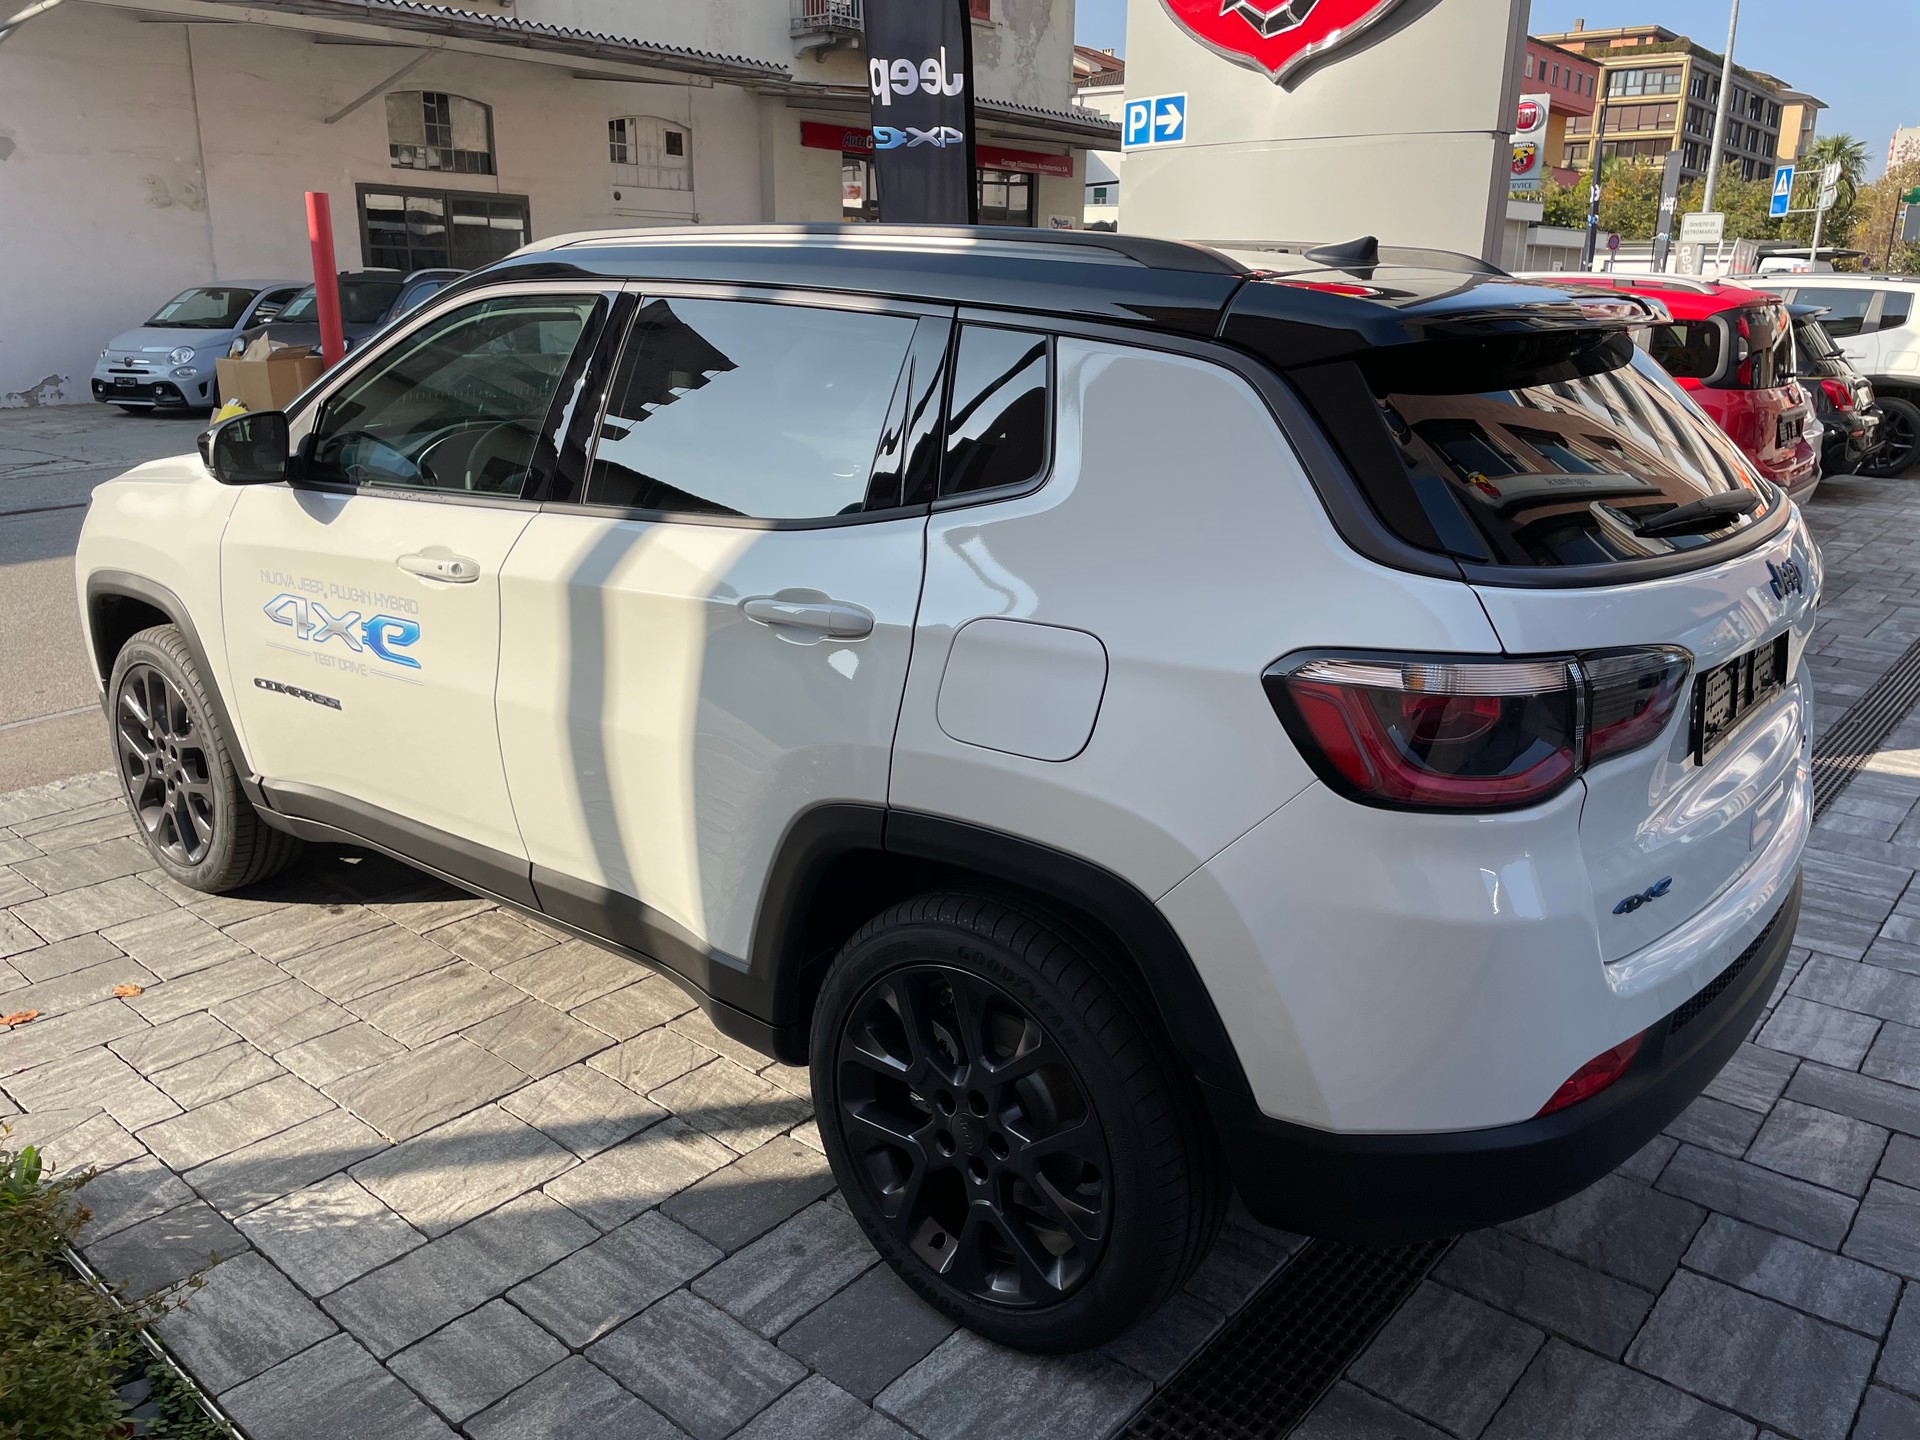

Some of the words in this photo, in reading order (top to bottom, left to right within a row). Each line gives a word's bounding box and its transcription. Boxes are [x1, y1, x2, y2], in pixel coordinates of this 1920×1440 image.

[842, 132, 873, 149] AutoC
[1129, 105, 1147, 142] P
[260, 569, 296, 590] NUOVA
[374, 591, 419, 614] HYBRID
[312, 651, 336, 668] TEST
[338, 658, 368, 677] DRIVE
[254, 677, 342, 711] COMPASS
[957, 945, 1079, 1046] GOODYEAR
